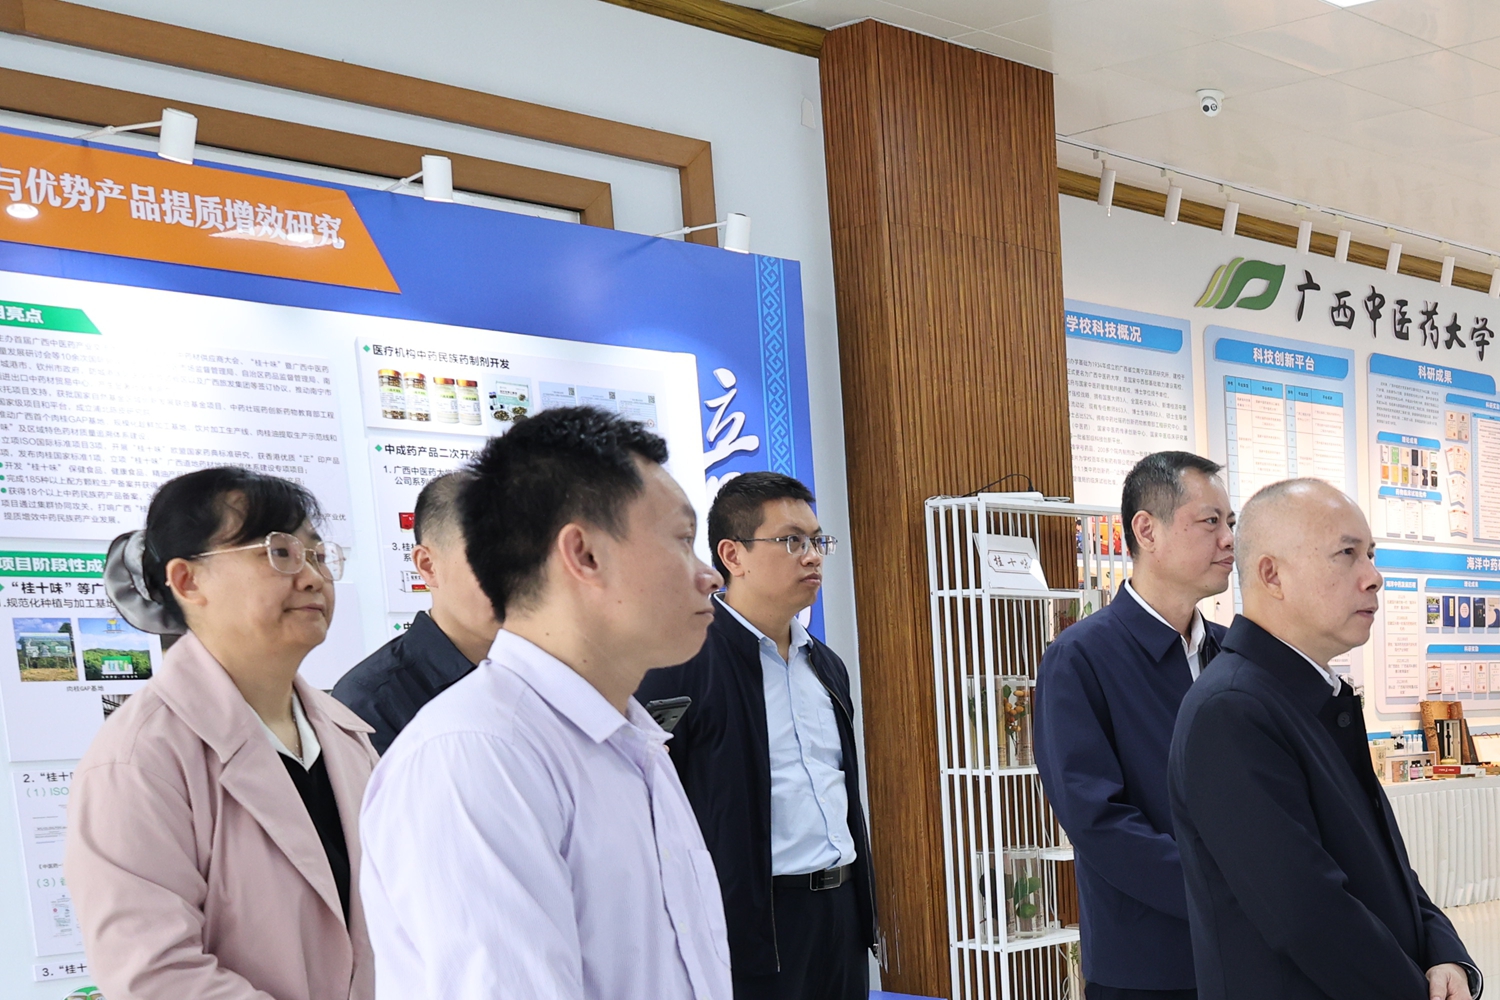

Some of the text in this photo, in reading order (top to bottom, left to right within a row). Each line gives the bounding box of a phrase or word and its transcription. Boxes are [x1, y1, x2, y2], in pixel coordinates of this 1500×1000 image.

[0, 166, 345, 249] 与优势产品提质增效研究
[1066, 313, 1142, 343] 学校科技概况
[1297, 270, 1495, 361] 广西中医药大学
[372, 344, 510, 370] 医疗机构中药民族药制剂开发
[1252, 346, 1315, 372] 科技创新平台
[1418, 364, 1453, 384] 科研成果
[0, 556, 106, 573] 项目阶段性成
